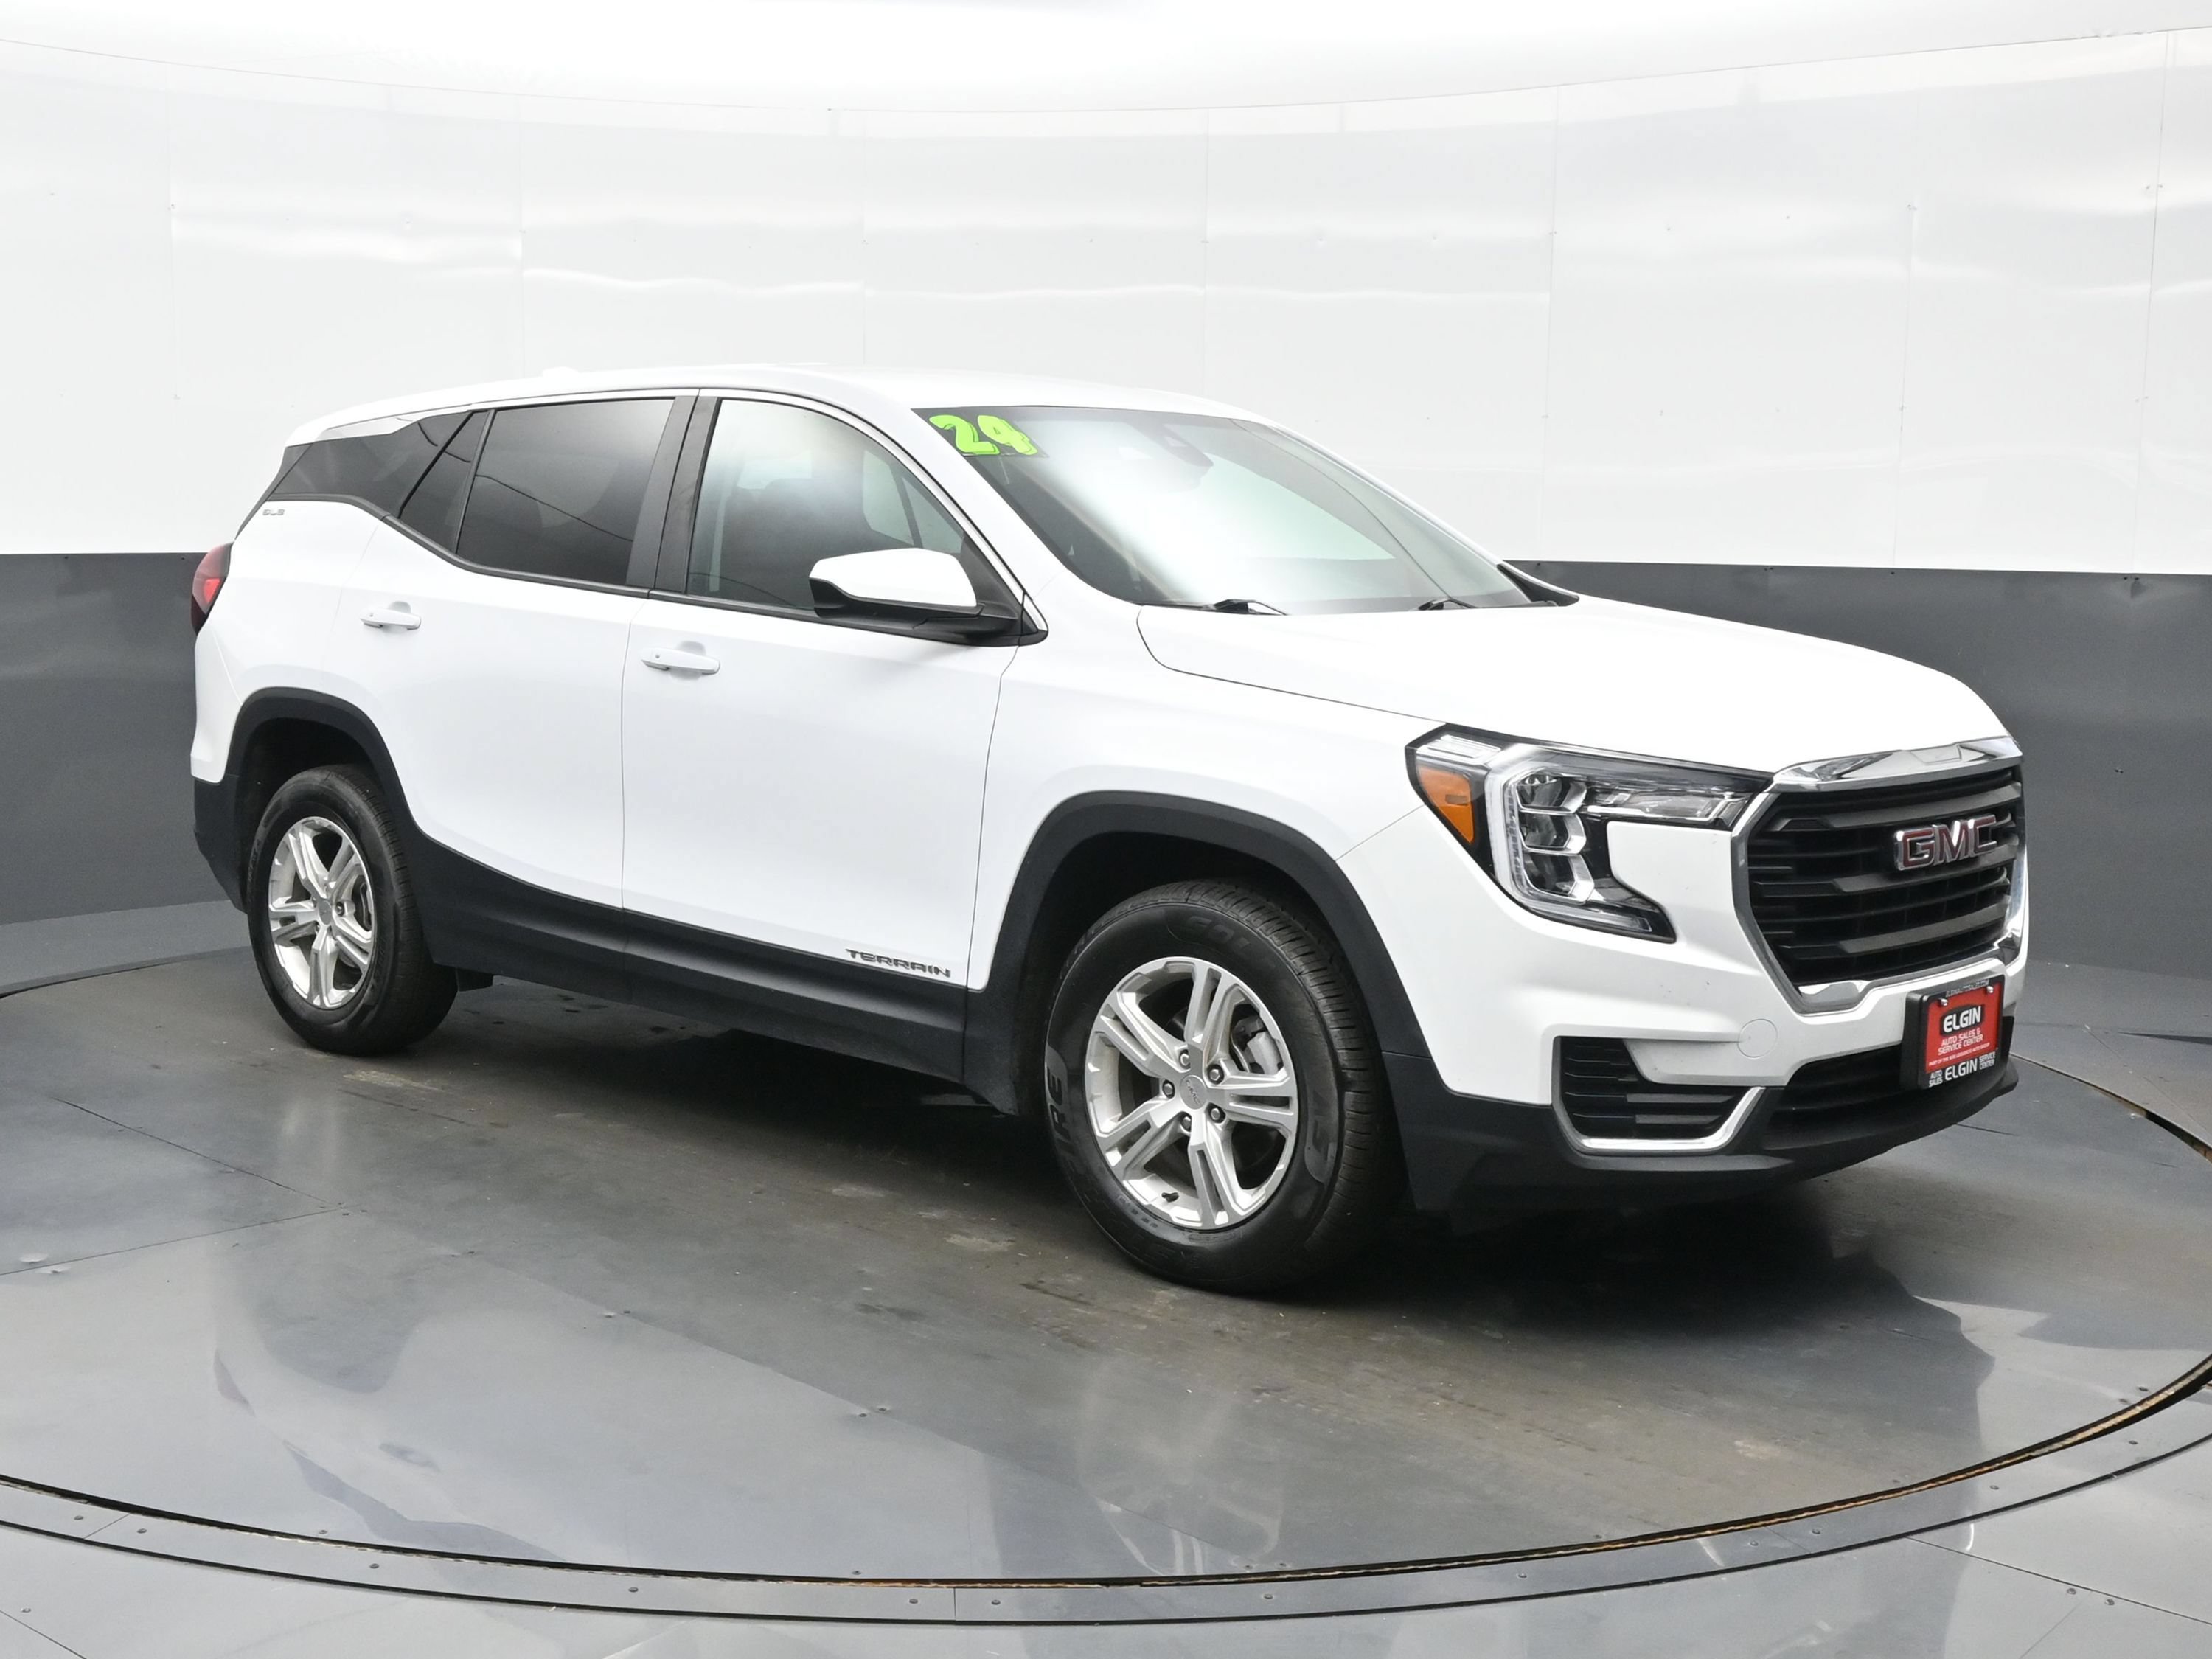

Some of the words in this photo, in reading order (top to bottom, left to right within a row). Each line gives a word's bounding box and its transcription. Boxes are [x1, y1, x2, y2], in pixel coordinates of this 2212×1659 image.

[929, 414, 1038, 456] 24
[1895, 814, 1997, 871] GMC
[845, 948, 951, 978] TERRAIN
[1944, 1006, 1981, 1033] ELGIN
[1938, 1042, 1962, 1056] SERVICE
[1963, 1034, 1983, 1047] CENTER
[1941, 1034, 1958, 1047] AUTO
[1958, 1029, 1976, 1043] SALES
[1979, 1051, 1996, 1063] SERVICE
[1979, 1059, 1994, 1070] CENTER
[1930, 1069, 1942, 1079] AUTO
[1944, 1058, 1978, 1081] ELGIN
[1185, 1079, 1201, 1105] GMC
[1928, 1076, 1943, 1088] SALES
